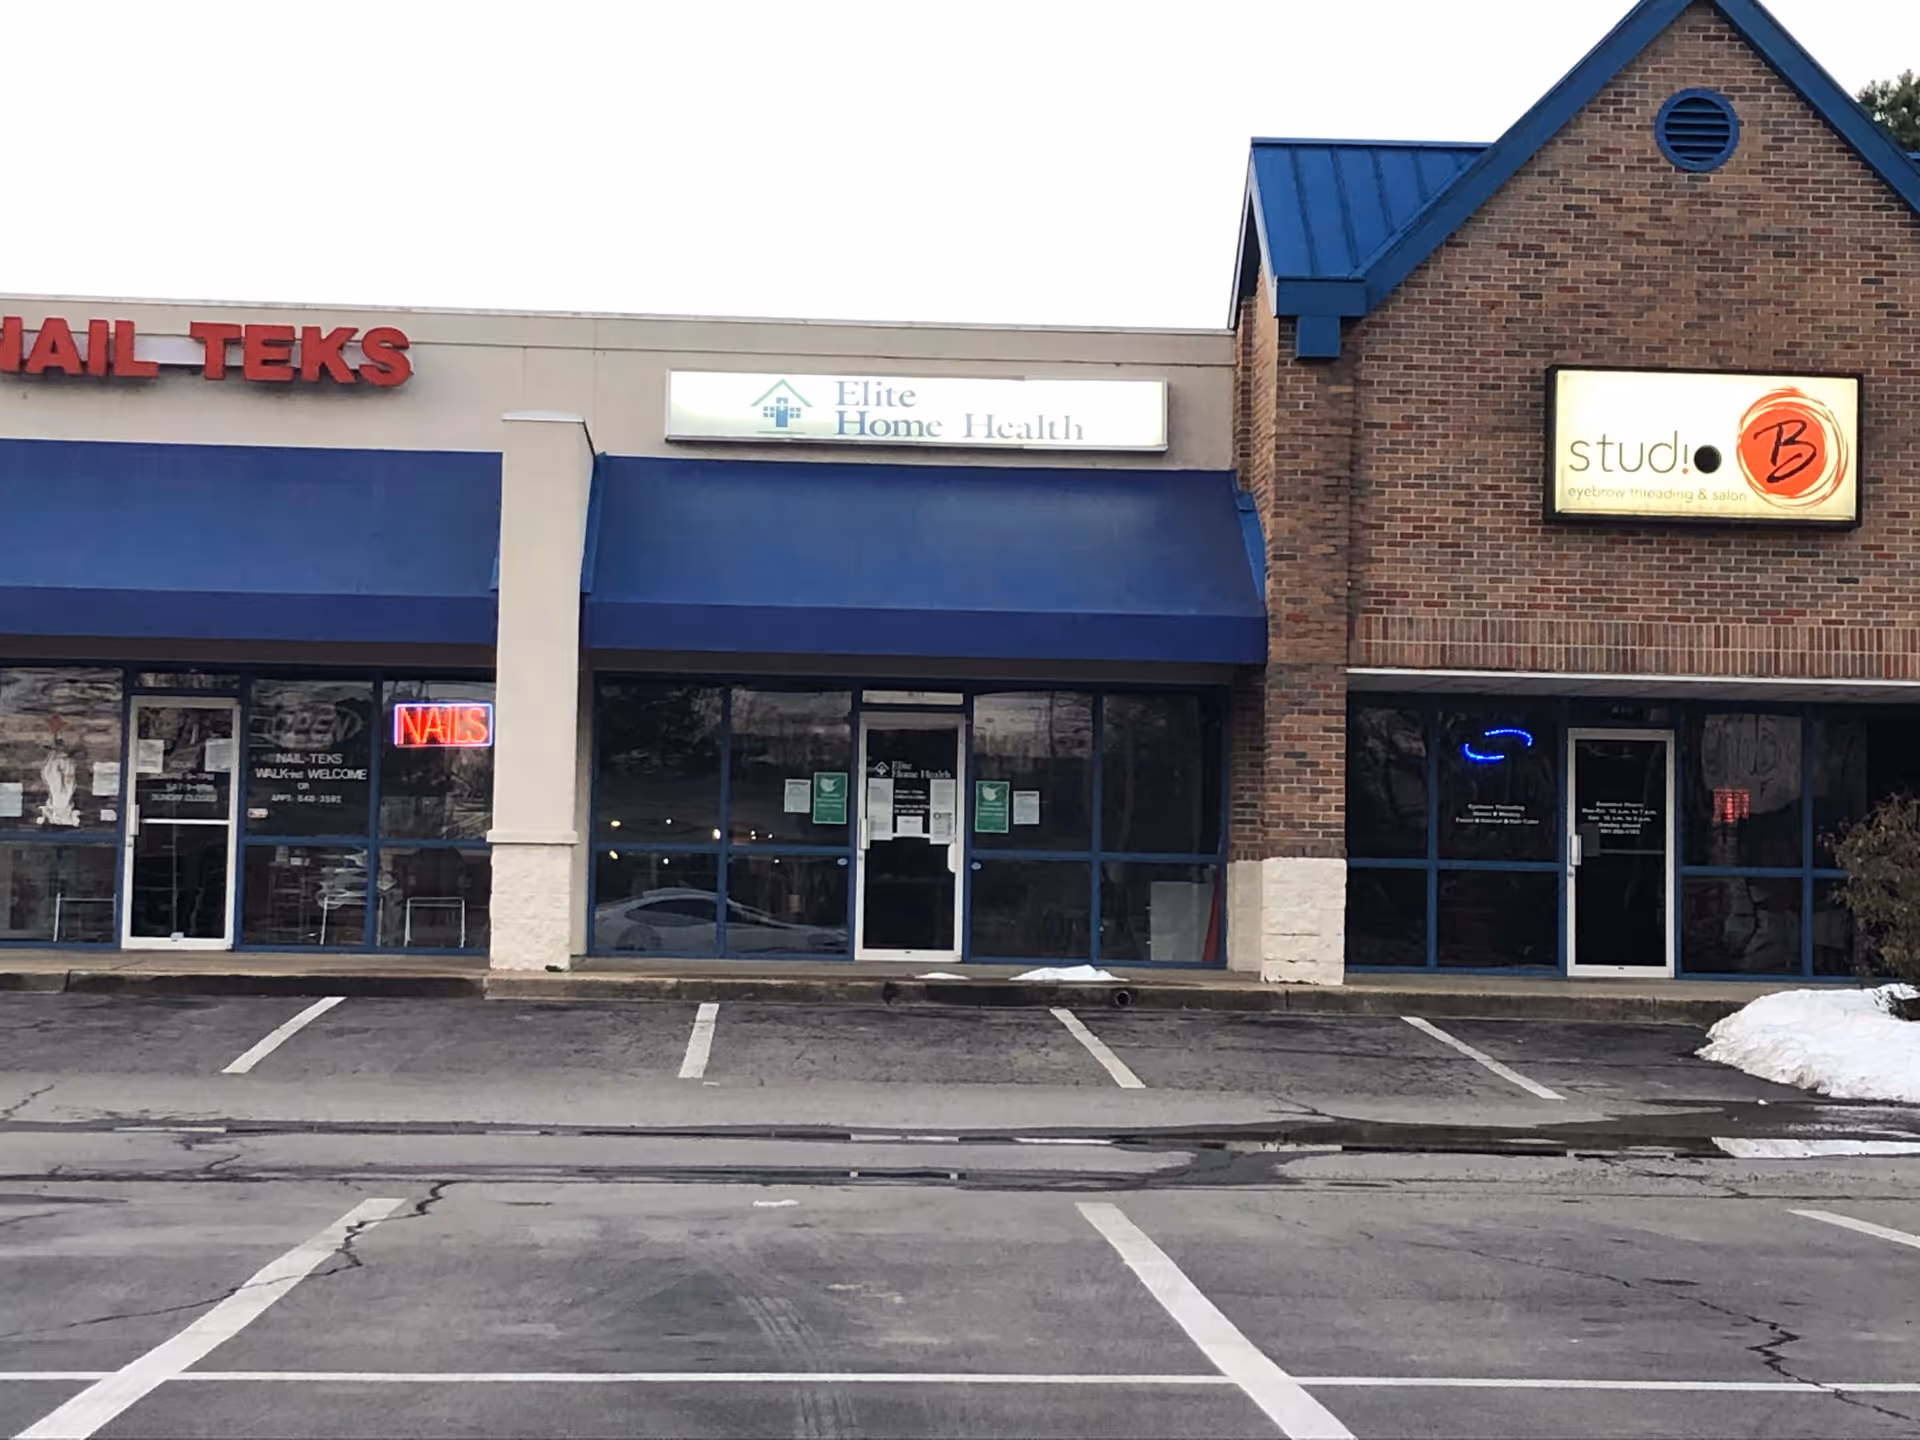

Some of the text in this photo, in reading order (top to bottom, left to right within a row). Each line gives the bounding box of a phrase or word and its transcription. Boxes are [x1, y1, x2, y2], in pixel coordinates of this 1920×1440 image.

[190, 321, 412, 387] TEKS
[834, 380, 917, 408] Elite
[833, 410, 1084, 440] Home Health
[1753, 419, 1818, 484] B
[1567, 487, 1747, 504] eyebrow threading & salon
[399, 706, 489, 745] NAILS
[307, 768, 368, 780] WELCOME
